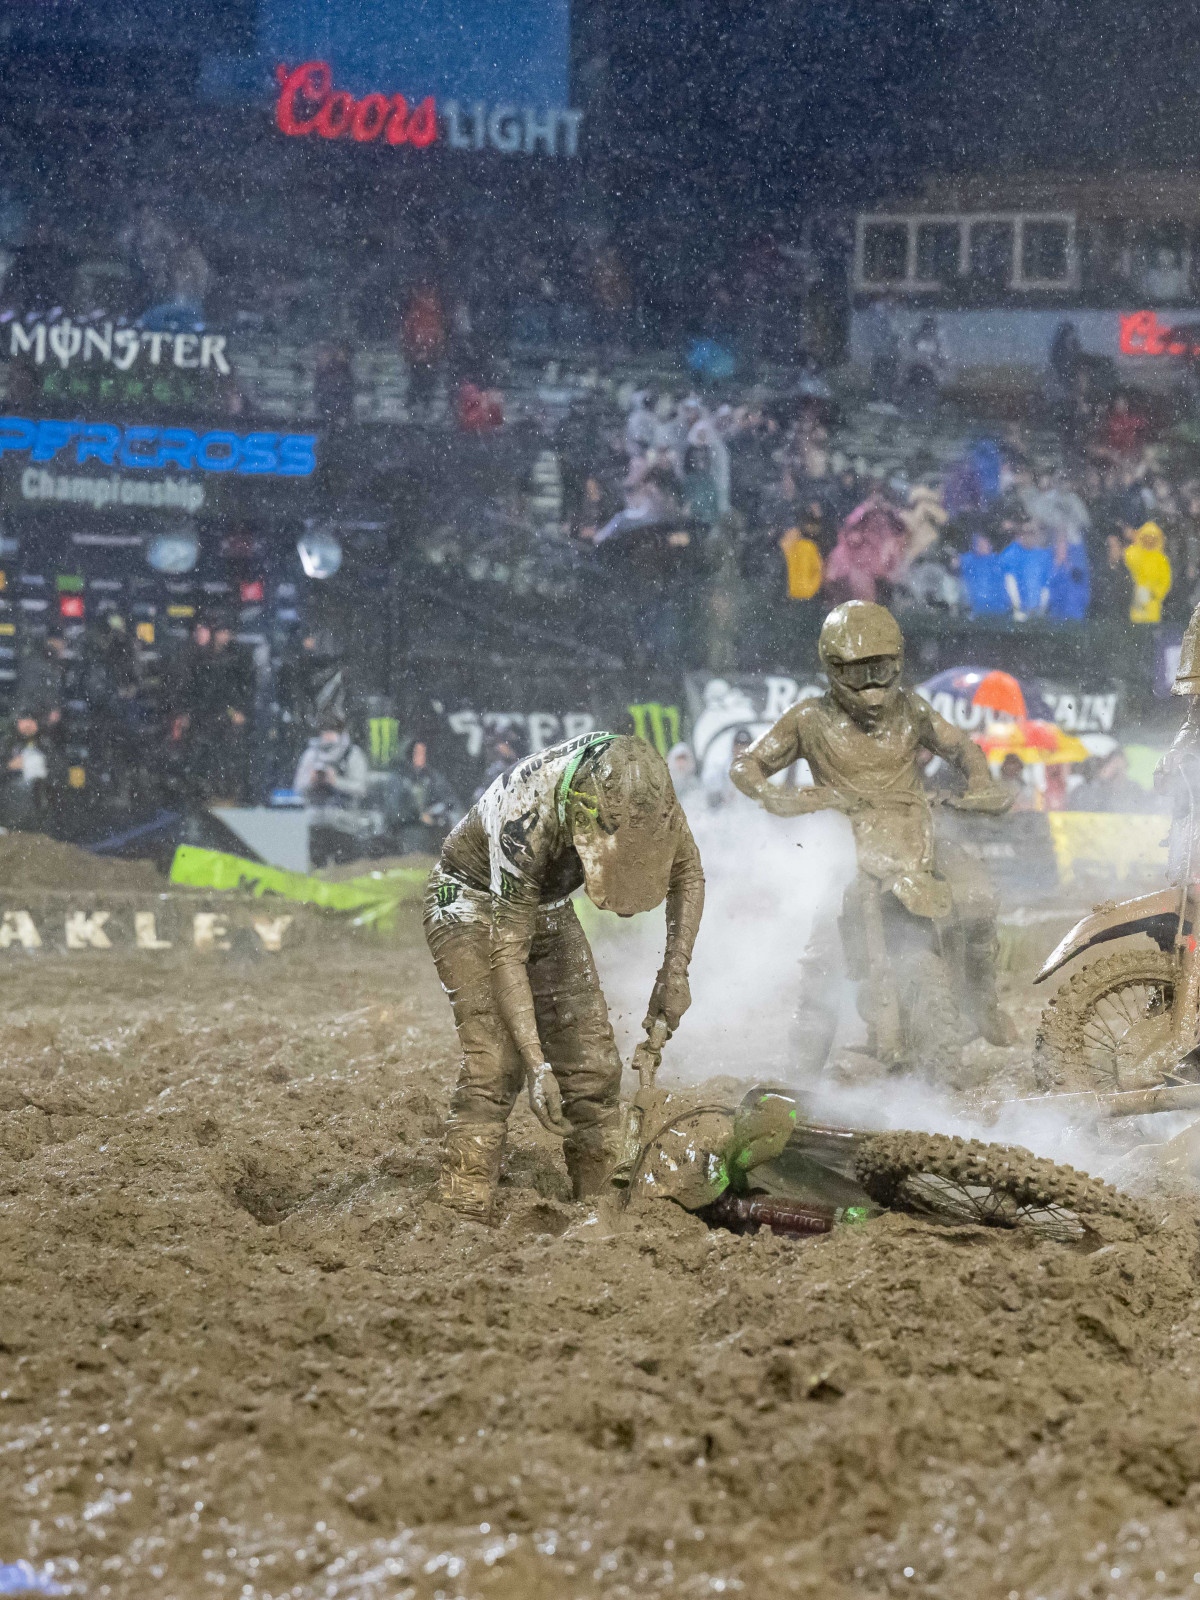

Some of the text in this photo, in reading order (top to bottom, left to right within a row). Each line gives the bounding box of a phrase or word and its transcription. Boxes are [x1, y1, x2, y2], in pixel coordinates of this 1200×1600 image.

[276, 61, 585, 155] Coors LIGHT
[9, 318, 231, 374] MONSTER
[21, 466, 205, 511] Championship
